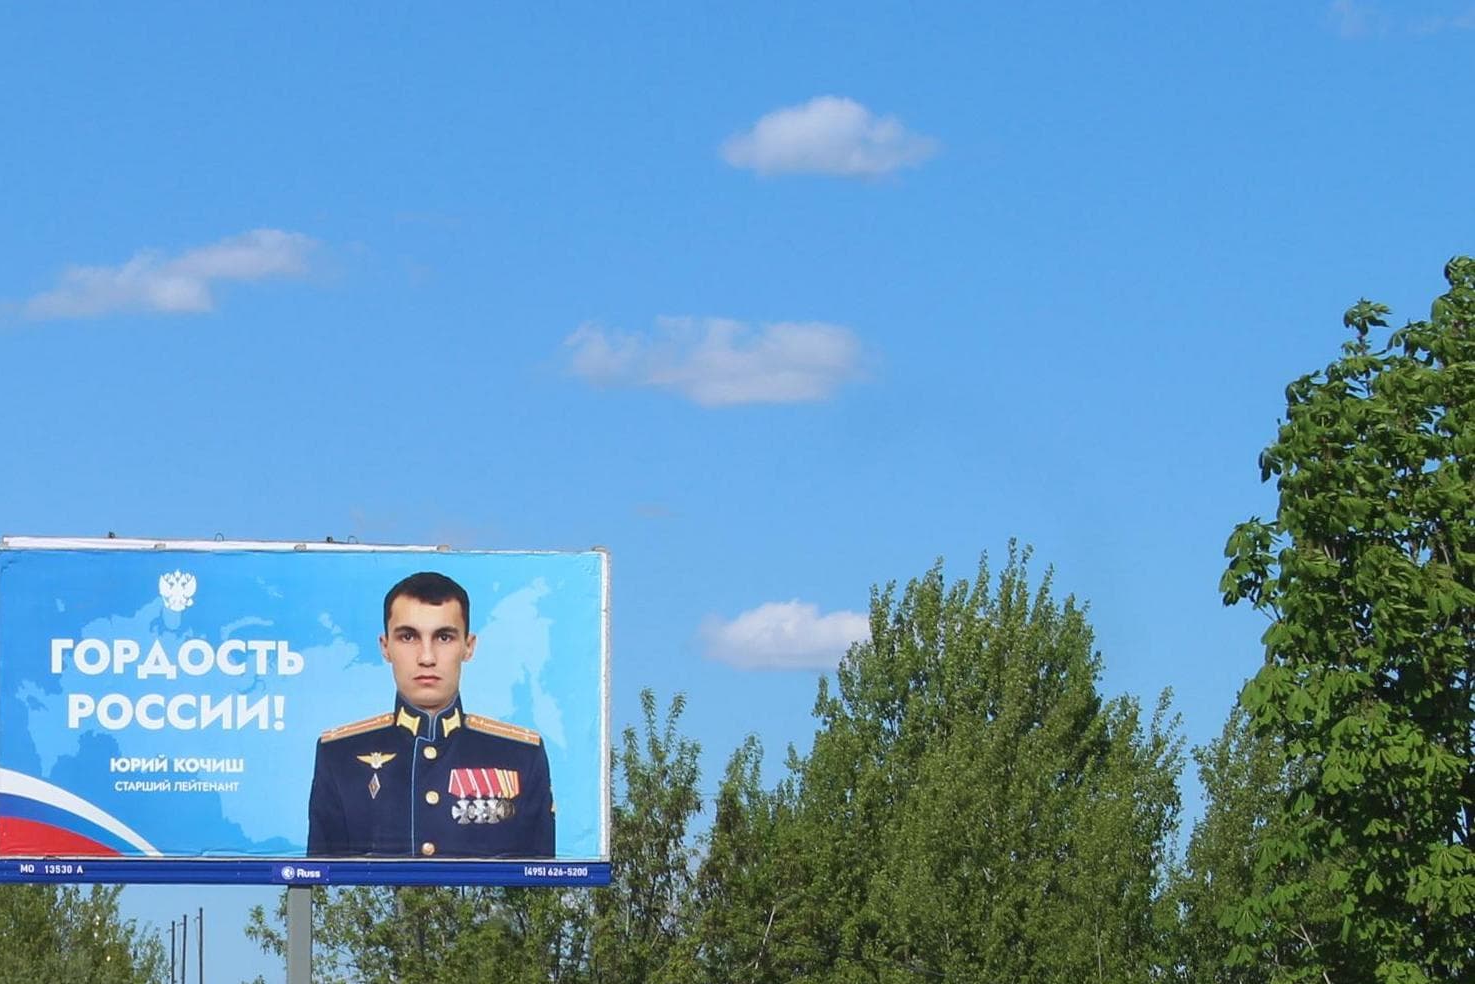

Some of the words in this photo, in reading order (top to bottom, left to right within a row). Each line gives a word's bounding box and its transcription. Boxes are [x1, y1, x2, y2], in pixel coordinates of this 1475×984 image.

[51, 638, 304, 679] ГОРДОСТЬ
[68, 694, 285, 731] РОССИИ!
[110, 754, 168, 773] ЮРИЙ
[174, 757, 244, 773] КОЧИШ
[115, 779, 171, 792] СТАРШИЙ
[173, 779, 239, 792] ЛЕЙТЕНАНТ
[45, 864, 73, 874] 13530
[296, 868, 321, 878] Russ
[524, 866, 546, 876] (495)
[547, 867, 588, 877] 626-5200
